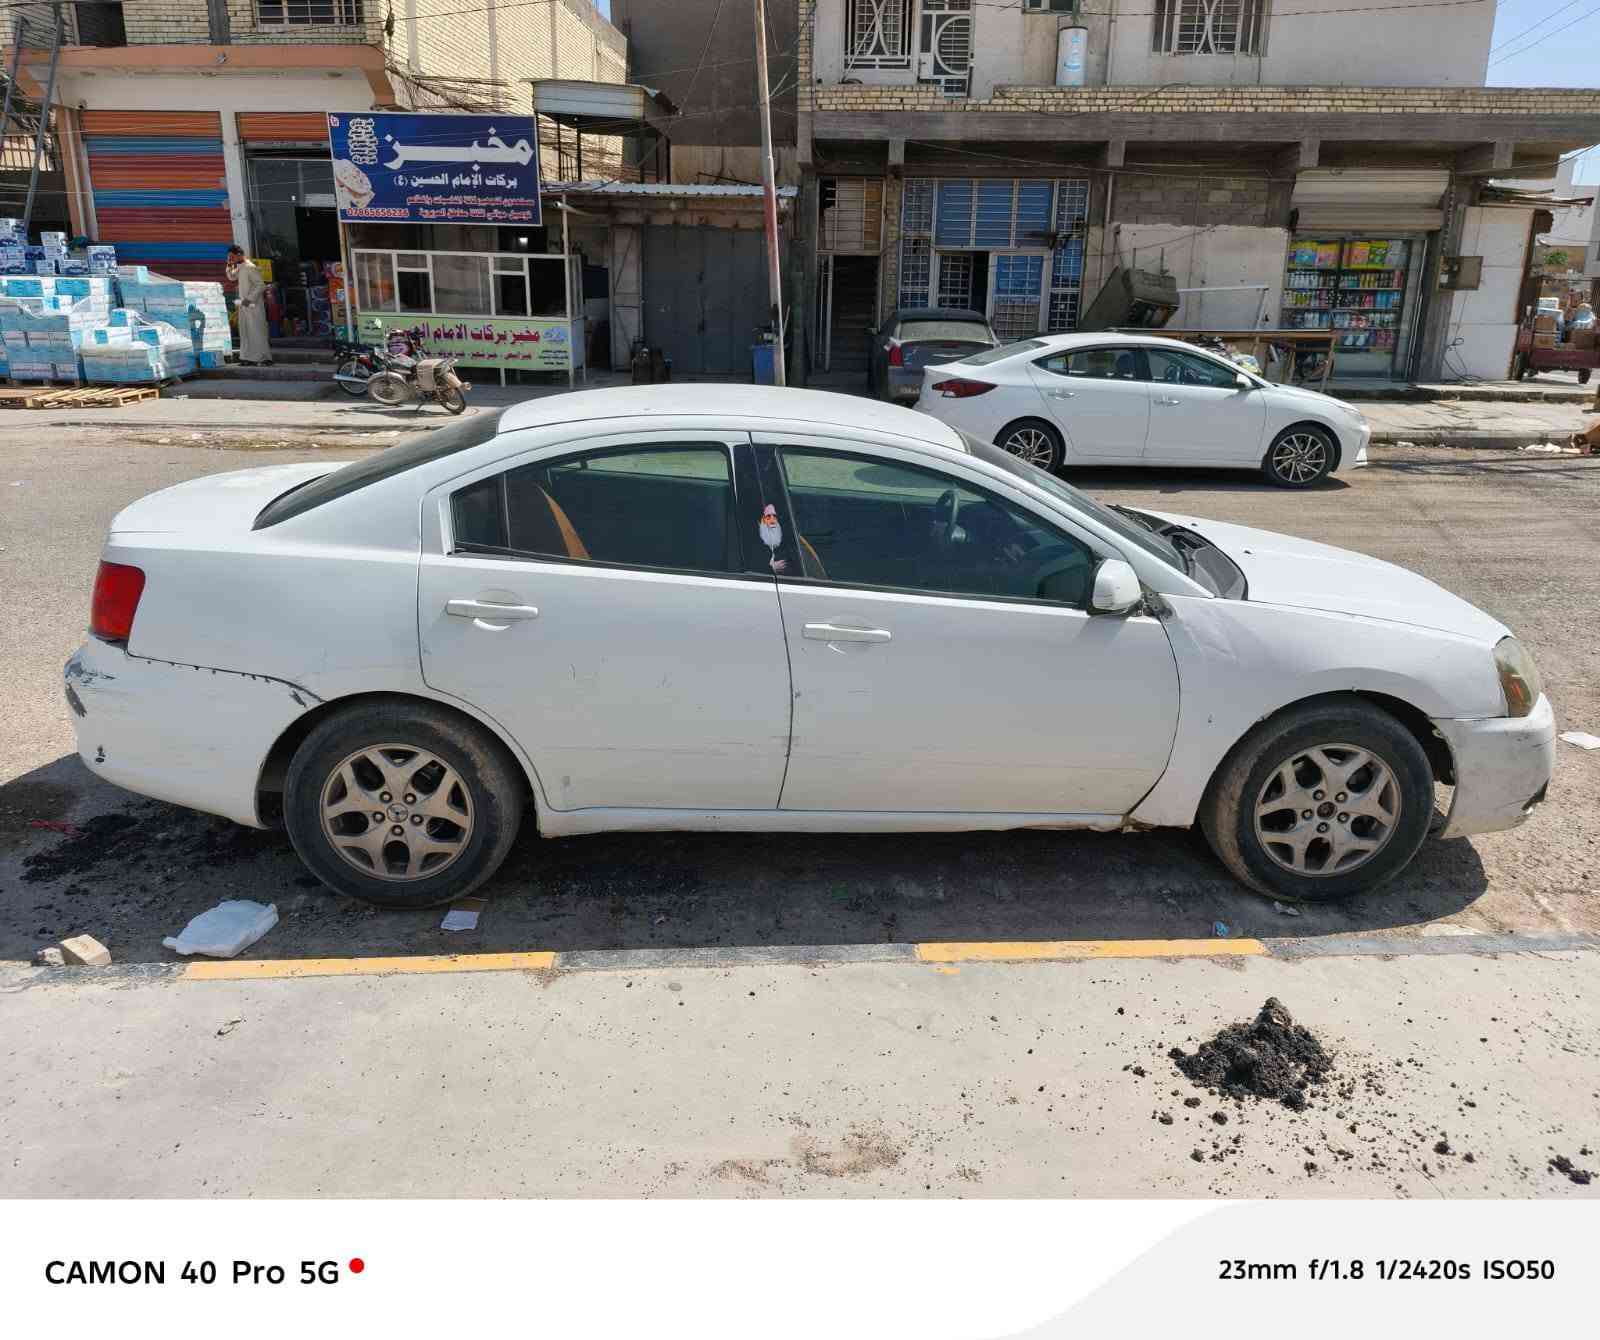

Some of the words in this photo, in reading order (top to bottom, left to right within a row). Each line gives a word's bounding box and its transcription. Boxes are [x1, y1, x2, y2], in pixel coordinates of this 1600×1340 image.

[384, 126, 535, 172] مخبز
[410, 173, 448, 188] الحسين
[485, 174, 518, 190] بركات
[470, 322, 508, 345] بركات
[511, 326, 541, 345] مخبز
